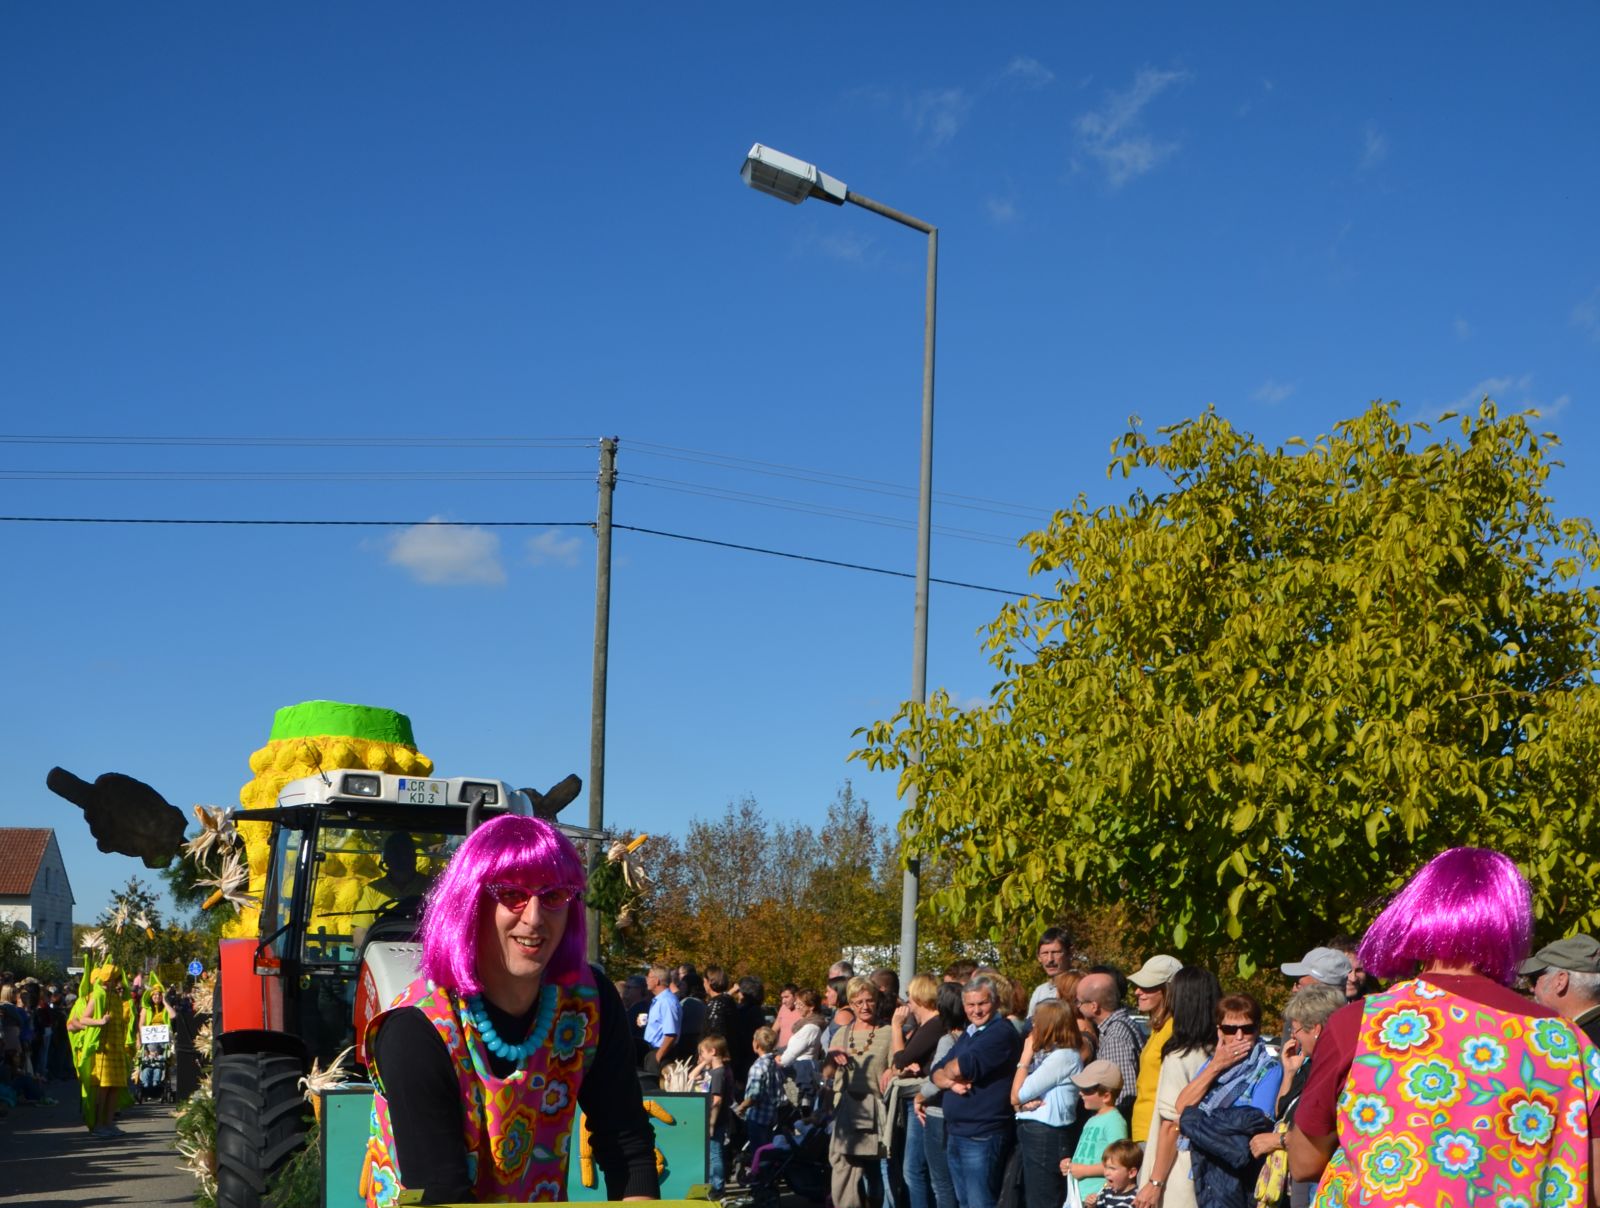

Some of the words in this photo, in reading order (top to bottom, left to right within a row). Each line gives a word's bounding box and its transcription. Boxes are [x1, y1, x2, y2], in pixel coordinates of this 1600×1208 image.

[411, 781, 425, 792] CR
[410, 793, 425, 803] KD
[428, 794, 435, 803] 3
